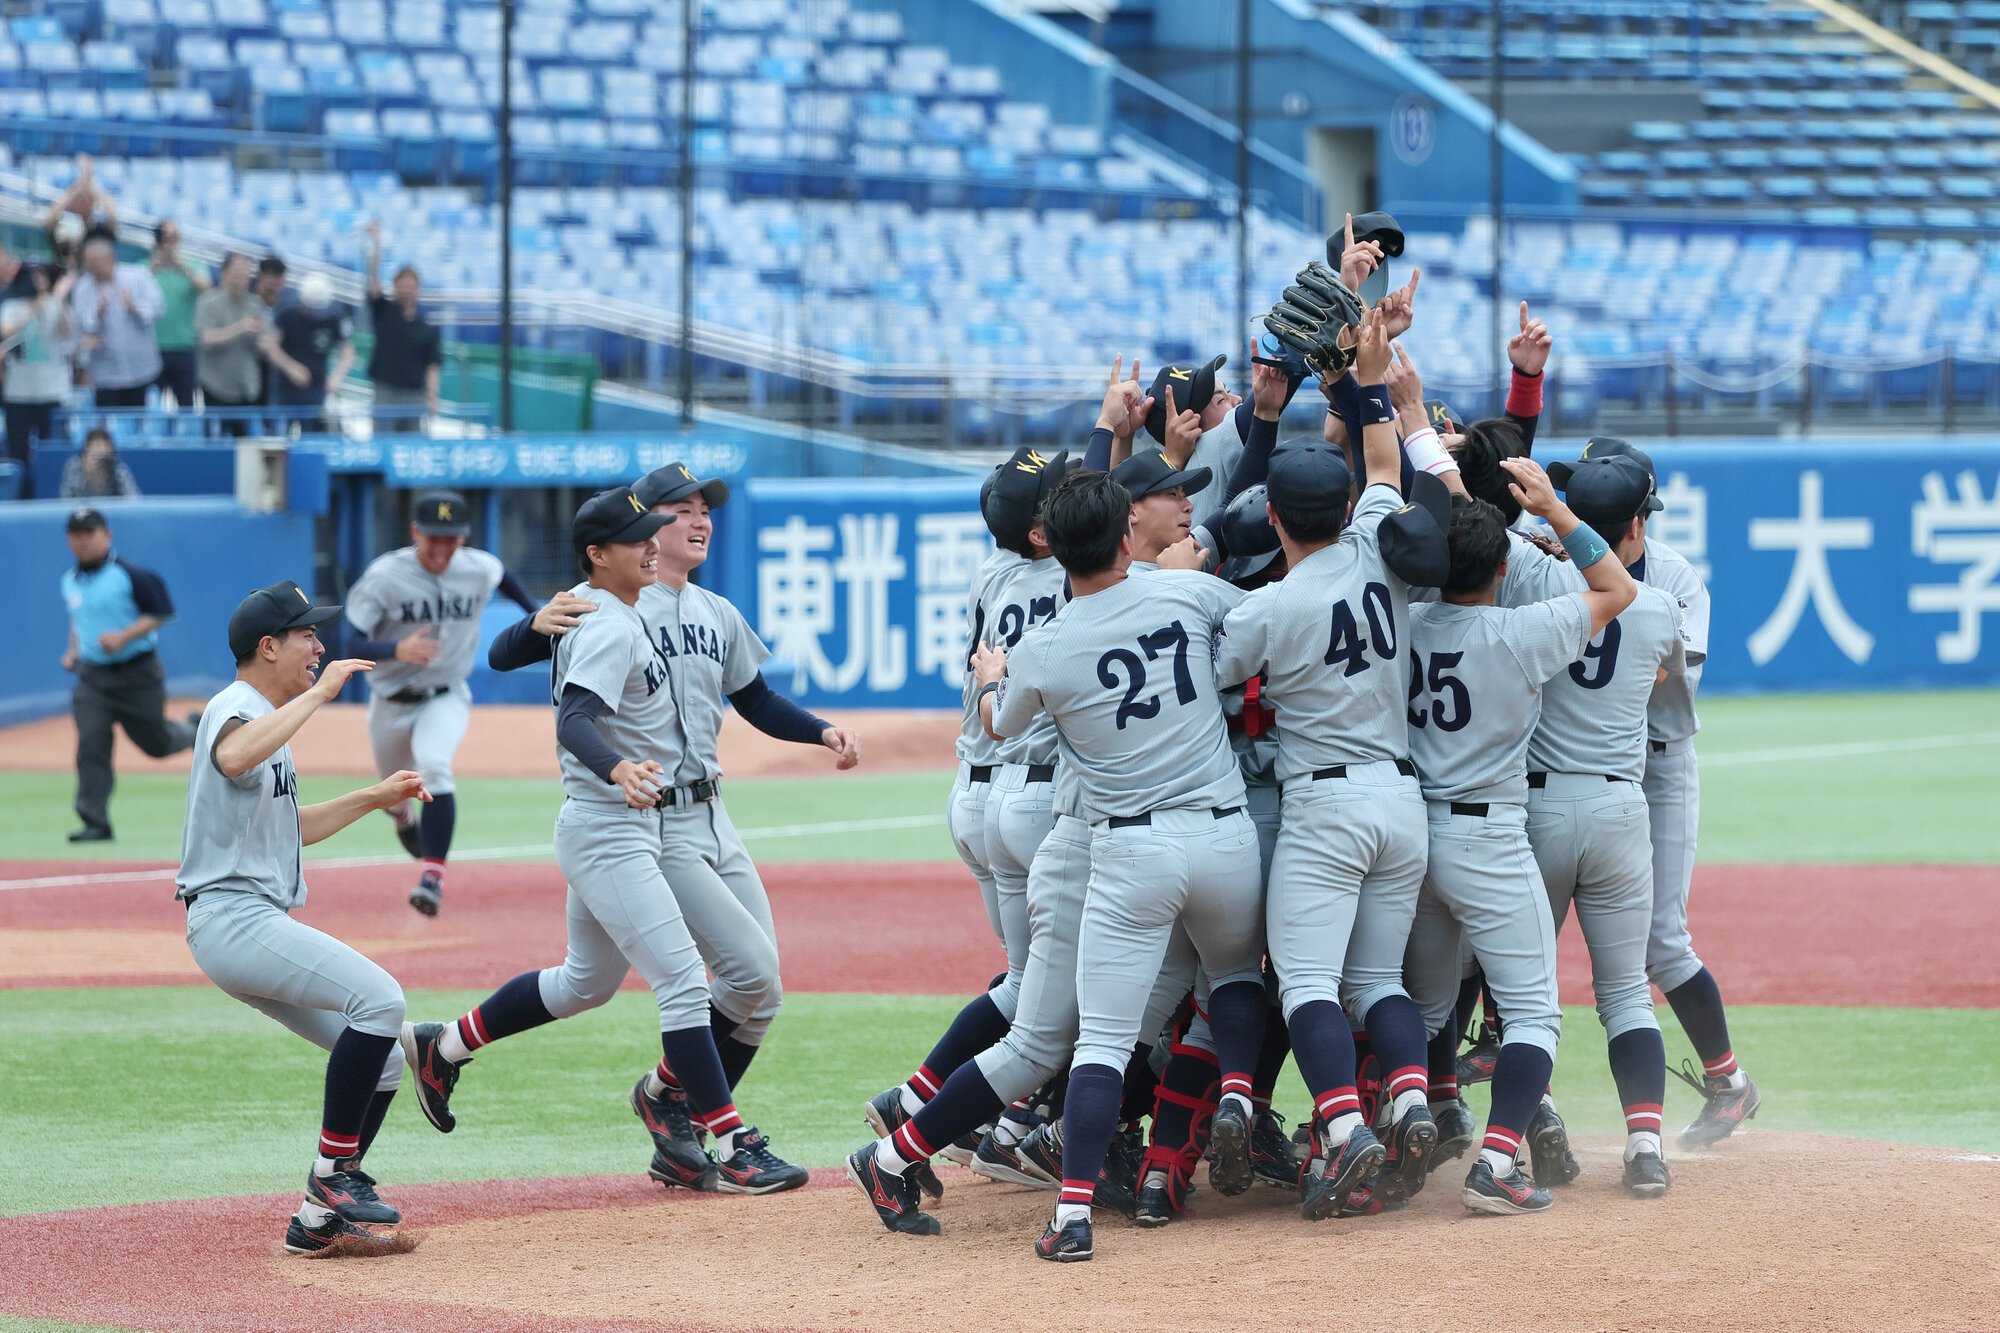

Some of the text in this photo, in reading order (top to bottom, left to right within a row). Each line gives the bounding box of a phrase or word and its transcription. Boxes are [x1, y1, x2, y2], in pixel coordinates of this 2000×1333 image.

[1169, 366, 1193, 381] K
[1432, 405, 1446, 421] K
[1016, 456, 1038, 474] K
[1027, 449, 1048, 468] K
[678, 466, 699, 482] K
[438, 502, 453, 521] K
[628, 495, 646, 513] K
[1324, 581, 1397, 677] 40
[1097, 620, 1198, 731] 27
[1408, 648, 1472, 732] 25
